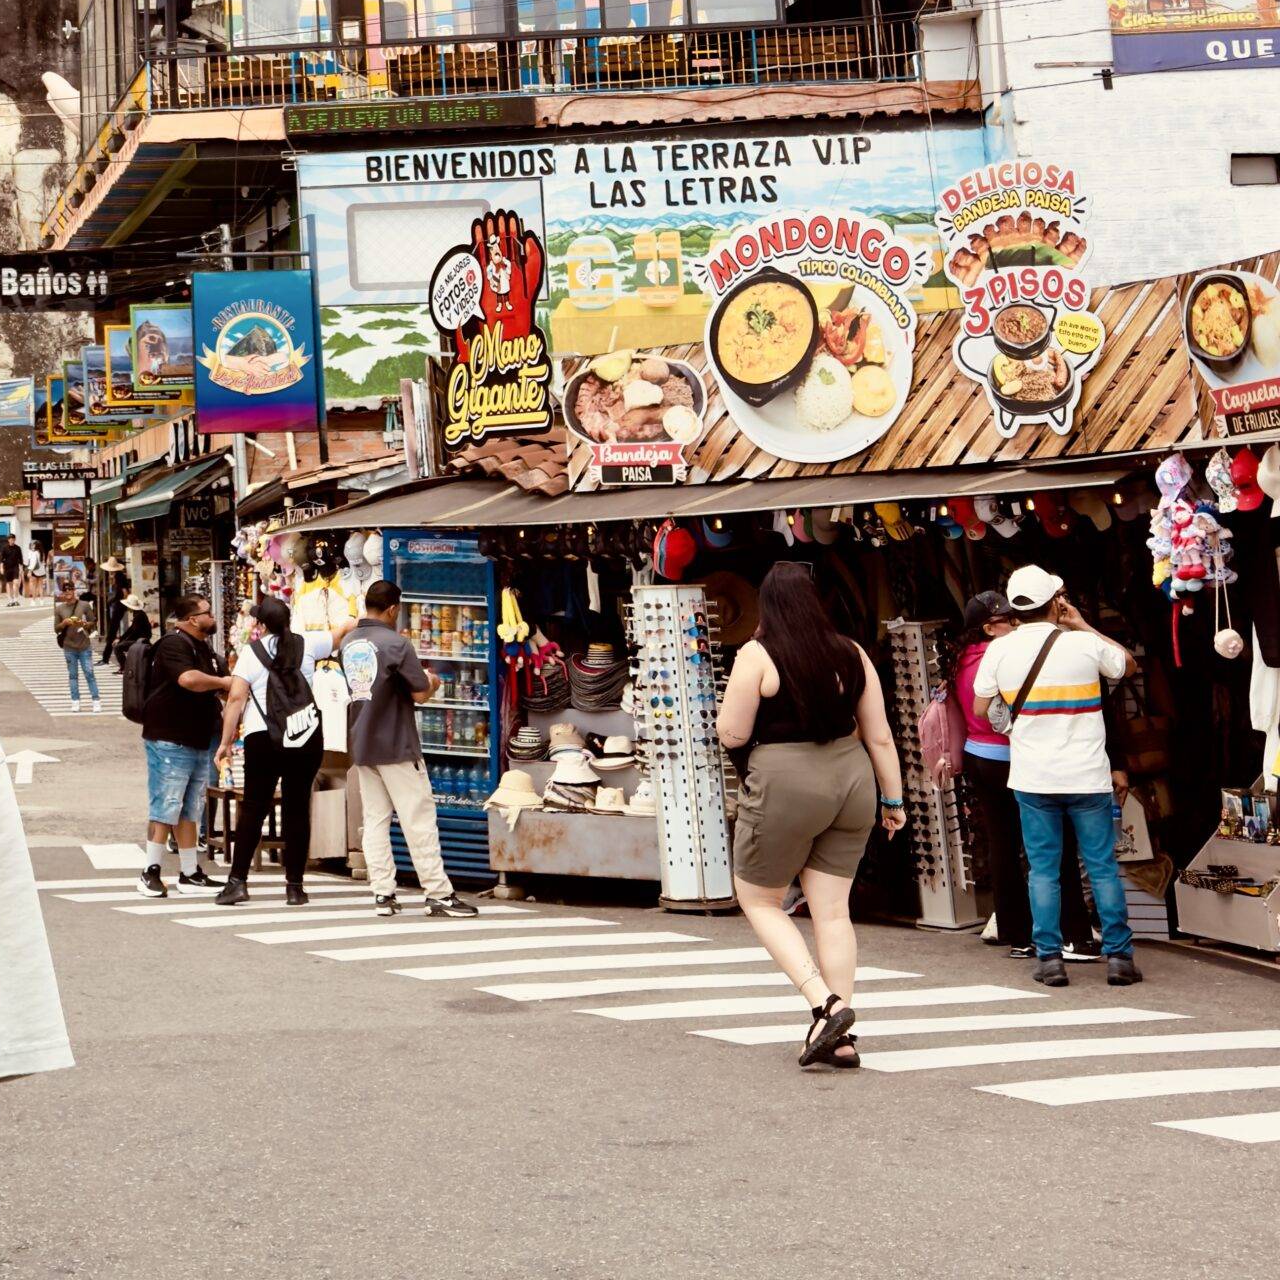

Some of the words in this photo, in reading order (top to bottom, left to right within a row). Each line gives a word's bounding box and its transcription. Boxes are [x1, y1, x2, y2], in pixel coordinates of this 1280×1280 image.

[1206, 38, 1274, 61] QUE
[366, 148, 555, 183] BIENVENIDOS
[574, 147, 590, 174] A
[604, 146, 637, 173] LA
[652, 140, 792, 173] TERRAZA
[590, 179, 647, 209] LAS
[665, 175, 778, 207] LETRAS
[942, 162, 1076, 214] DELICIOSA
[953, 189, 1021, 233] BANDEJA
[1024, 189, 1073, 218] PAISA
[709, 215, 910, 290] MONDONGO
[1, 266, 82, 296] Baños
[434, 284, 446, 304] TUS
[444, 255, 471, 287] MEJORES
[438, 277, 467, 318] FOTOS
[453, 282, 479, 316] VIDEOS
[797, 257, 837, 277] TÍPICO
[840, 263, 911, 329] COLOMBIANO
[964, 286, 991, 335] 3
[989, 268, 1086, 309] PISOS
[470, 321, 543, 382] Mano
[445, 362, 549, 441] Gigante
[1221, 383, 1280, 414] Cazuela
[1232, 416, 1245, 433] DE
[1244, 409, 1280, 432] FRIJOLES
[600, 444, 673, 468] Bandeja
[622, 466, 653, 482] PAISA
[185, 506, 210, 521] WC
[286, 701, 319, 738] NIKE
